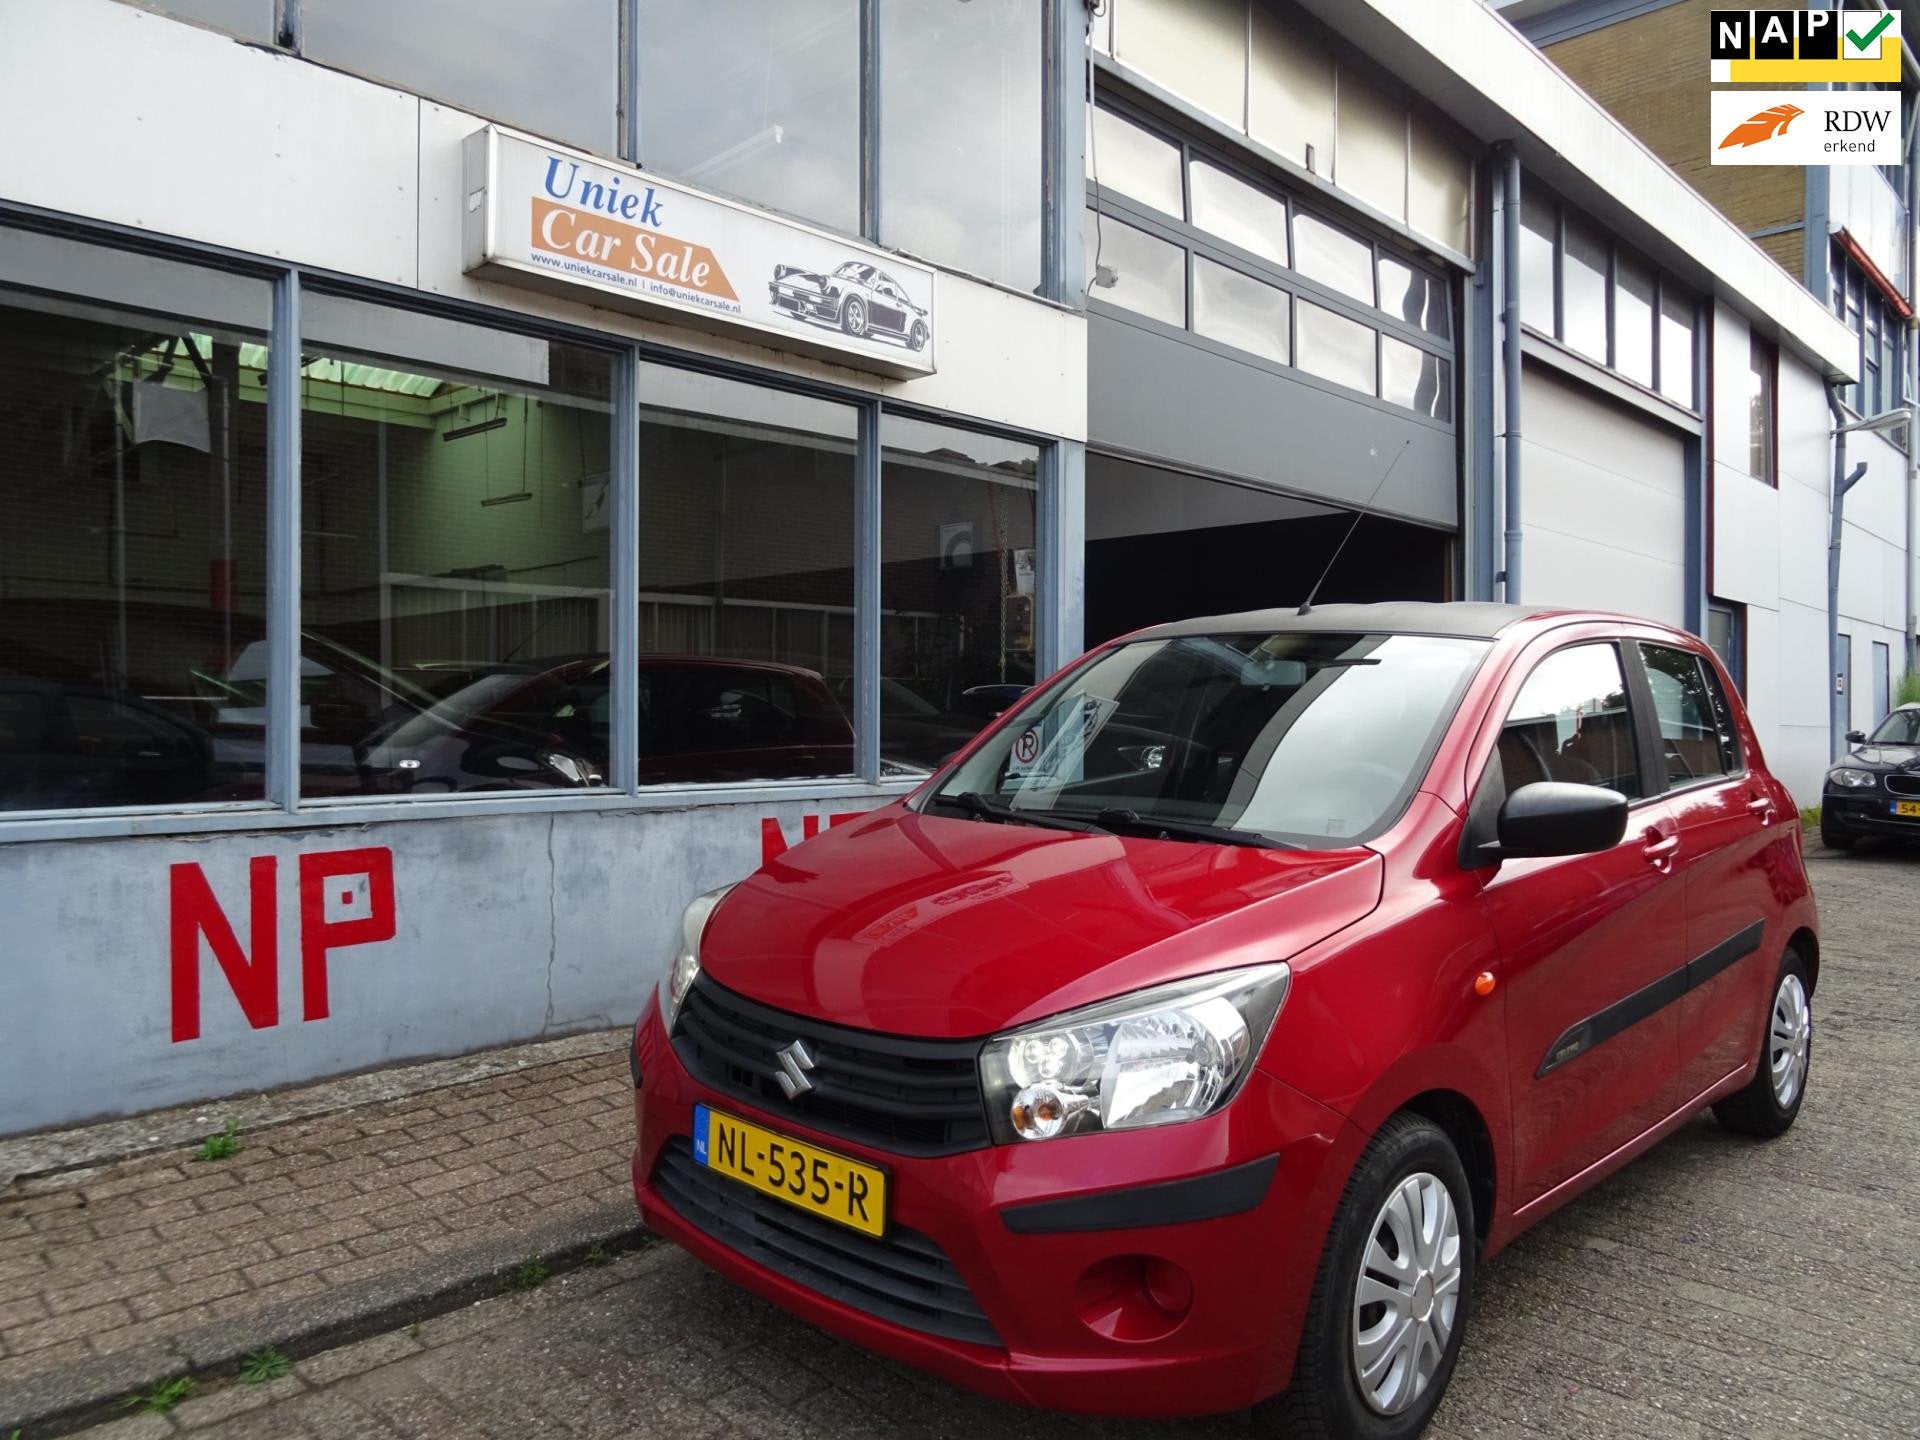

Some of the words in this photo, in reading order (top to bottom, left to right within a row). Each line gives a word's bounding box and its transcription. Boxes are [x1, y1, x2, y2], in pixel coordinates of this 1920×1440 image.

[544, 155, 664, 227] Uniek
[531, 253, 638, 287] www.uniekcarsale.nl
[650, 282, 741, 314] info@uniekcarsale.nl
[542, 209, 622, 261] Car
[631, 233, 710, 287] Sale
[170, 846, 396, 1043] NP
[718, 1122, 869, 1222] NL-535-R
